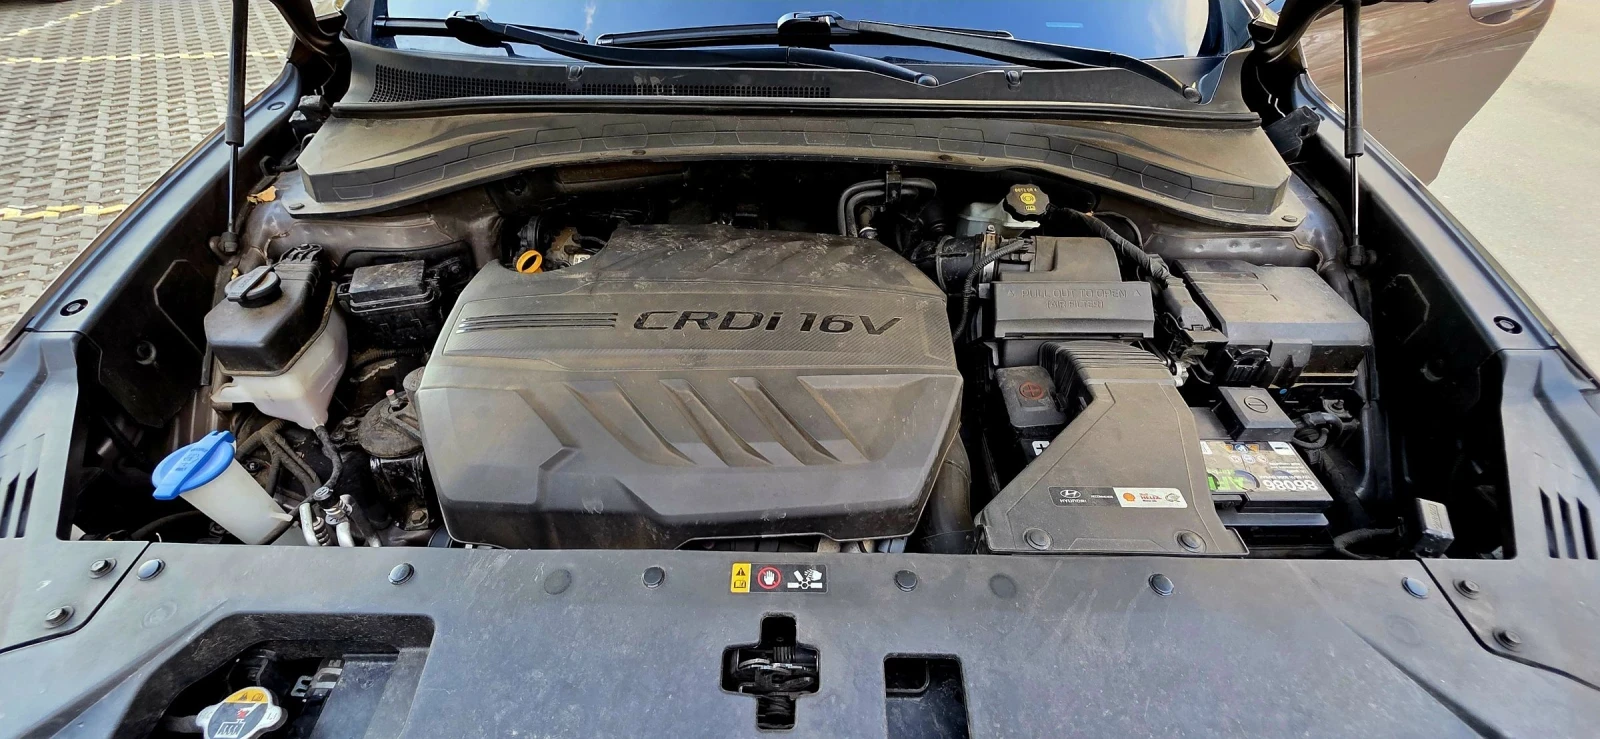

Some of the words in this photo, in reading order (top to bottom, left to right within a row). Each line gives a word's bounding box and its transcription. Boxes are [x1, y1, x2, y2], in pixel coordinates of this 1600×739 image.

[1021, 289, 1051, 298] PULL
[1053, 289, 1076, 298] OUT
[1079, 289, 1095, 298] TO
[1096, 289, 1128, 299] OPEN
[633, 310, 783, 331] CRDi
[799, 312, 902, 336] 16V
